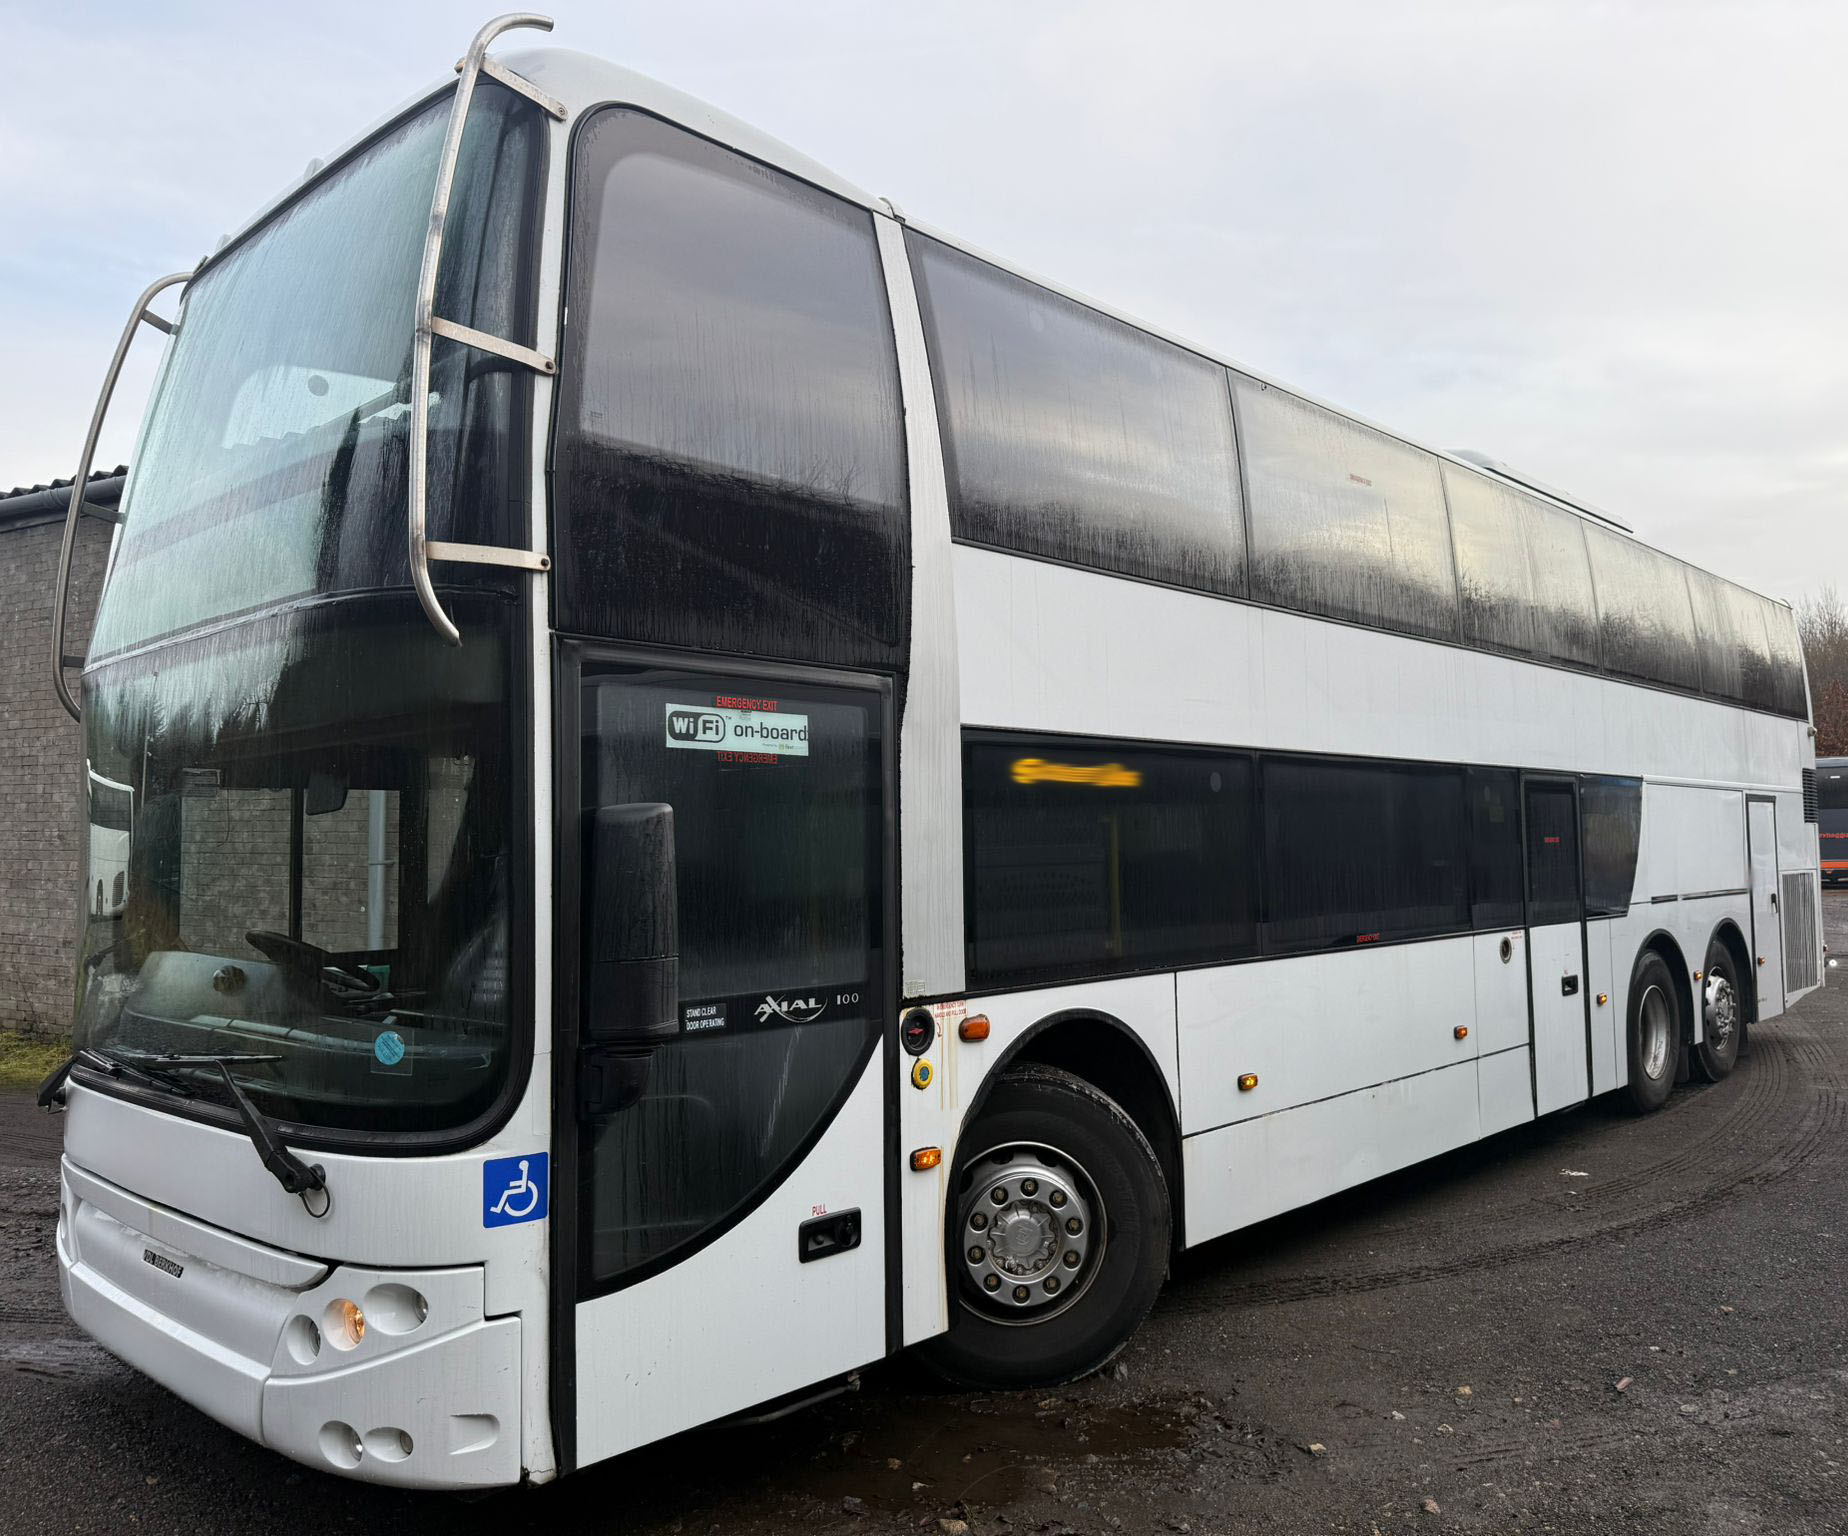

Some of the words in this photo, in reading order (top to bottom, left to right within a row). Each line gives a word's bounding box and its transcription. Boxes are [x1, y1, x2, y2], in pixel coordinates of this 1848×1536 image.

[716, 696, 761, 711] EMERGENCY
[762, 700, 777, 711] EXIT
[733, 722, 807, 741] on-board
[686, 1008, 701, 1018] STAND
[701, 1006, 717, 1017] CLEAR
[754, 996, 822, 1022] AXIAL
[836, 993, 859, 1005] 100
[686, 1020, 700, 1030] DOOR
[700, 1018, 725, 1029] OPERATING
[812, 1204, 827, 1216] PULL
